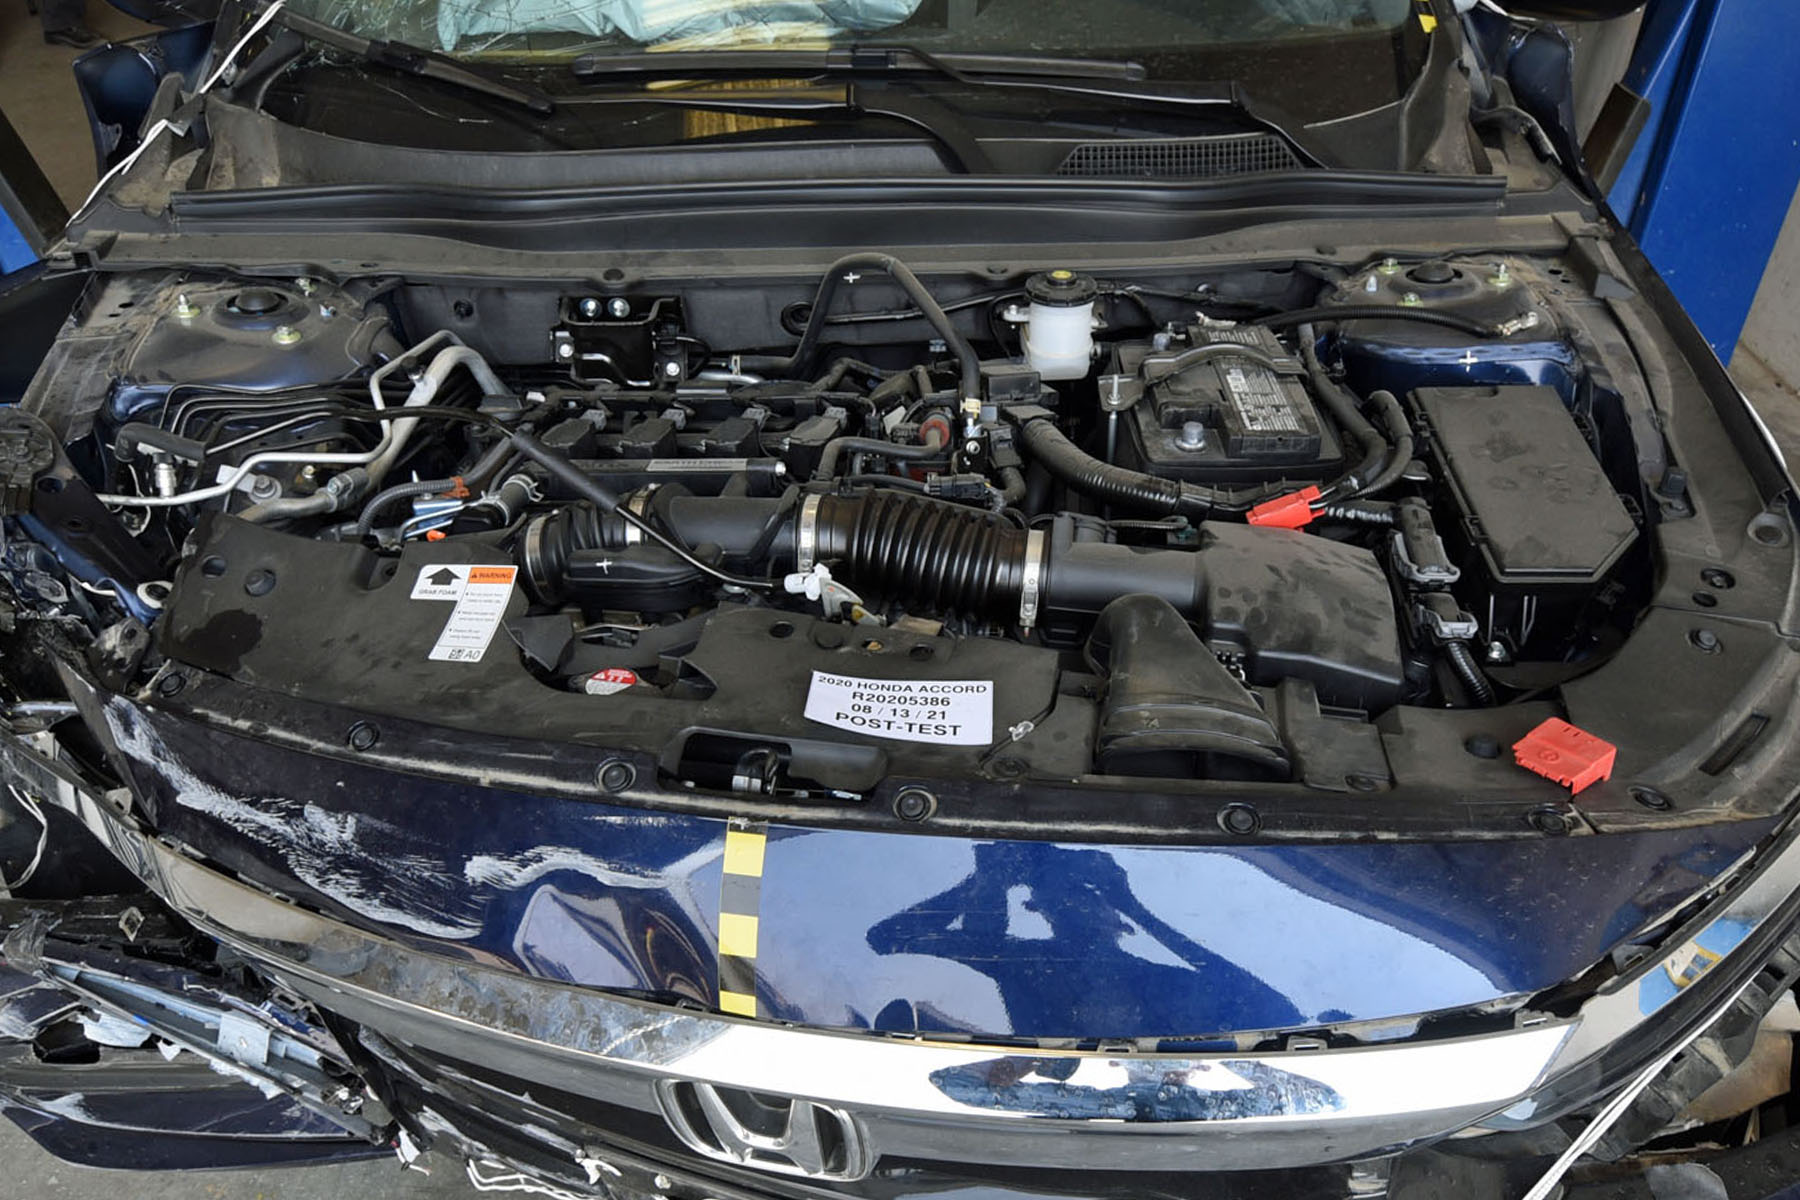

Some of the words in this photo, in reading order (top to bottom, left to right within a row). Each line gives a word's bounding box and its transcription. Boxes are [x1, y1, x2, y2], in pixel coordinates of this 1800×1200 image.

[818, 675, 852, 688] 2020
[857, 682, 913, 693] HONDA
[919, 684, 987, 694] ACCORD
[852, 691, 951, 707] R20205386
[851, 703, 872, 714] 08
[891, 708, 910, 718] 13
[927, 710, 946, 720] 21
[835, 712, 962, 736] POST-TEST
